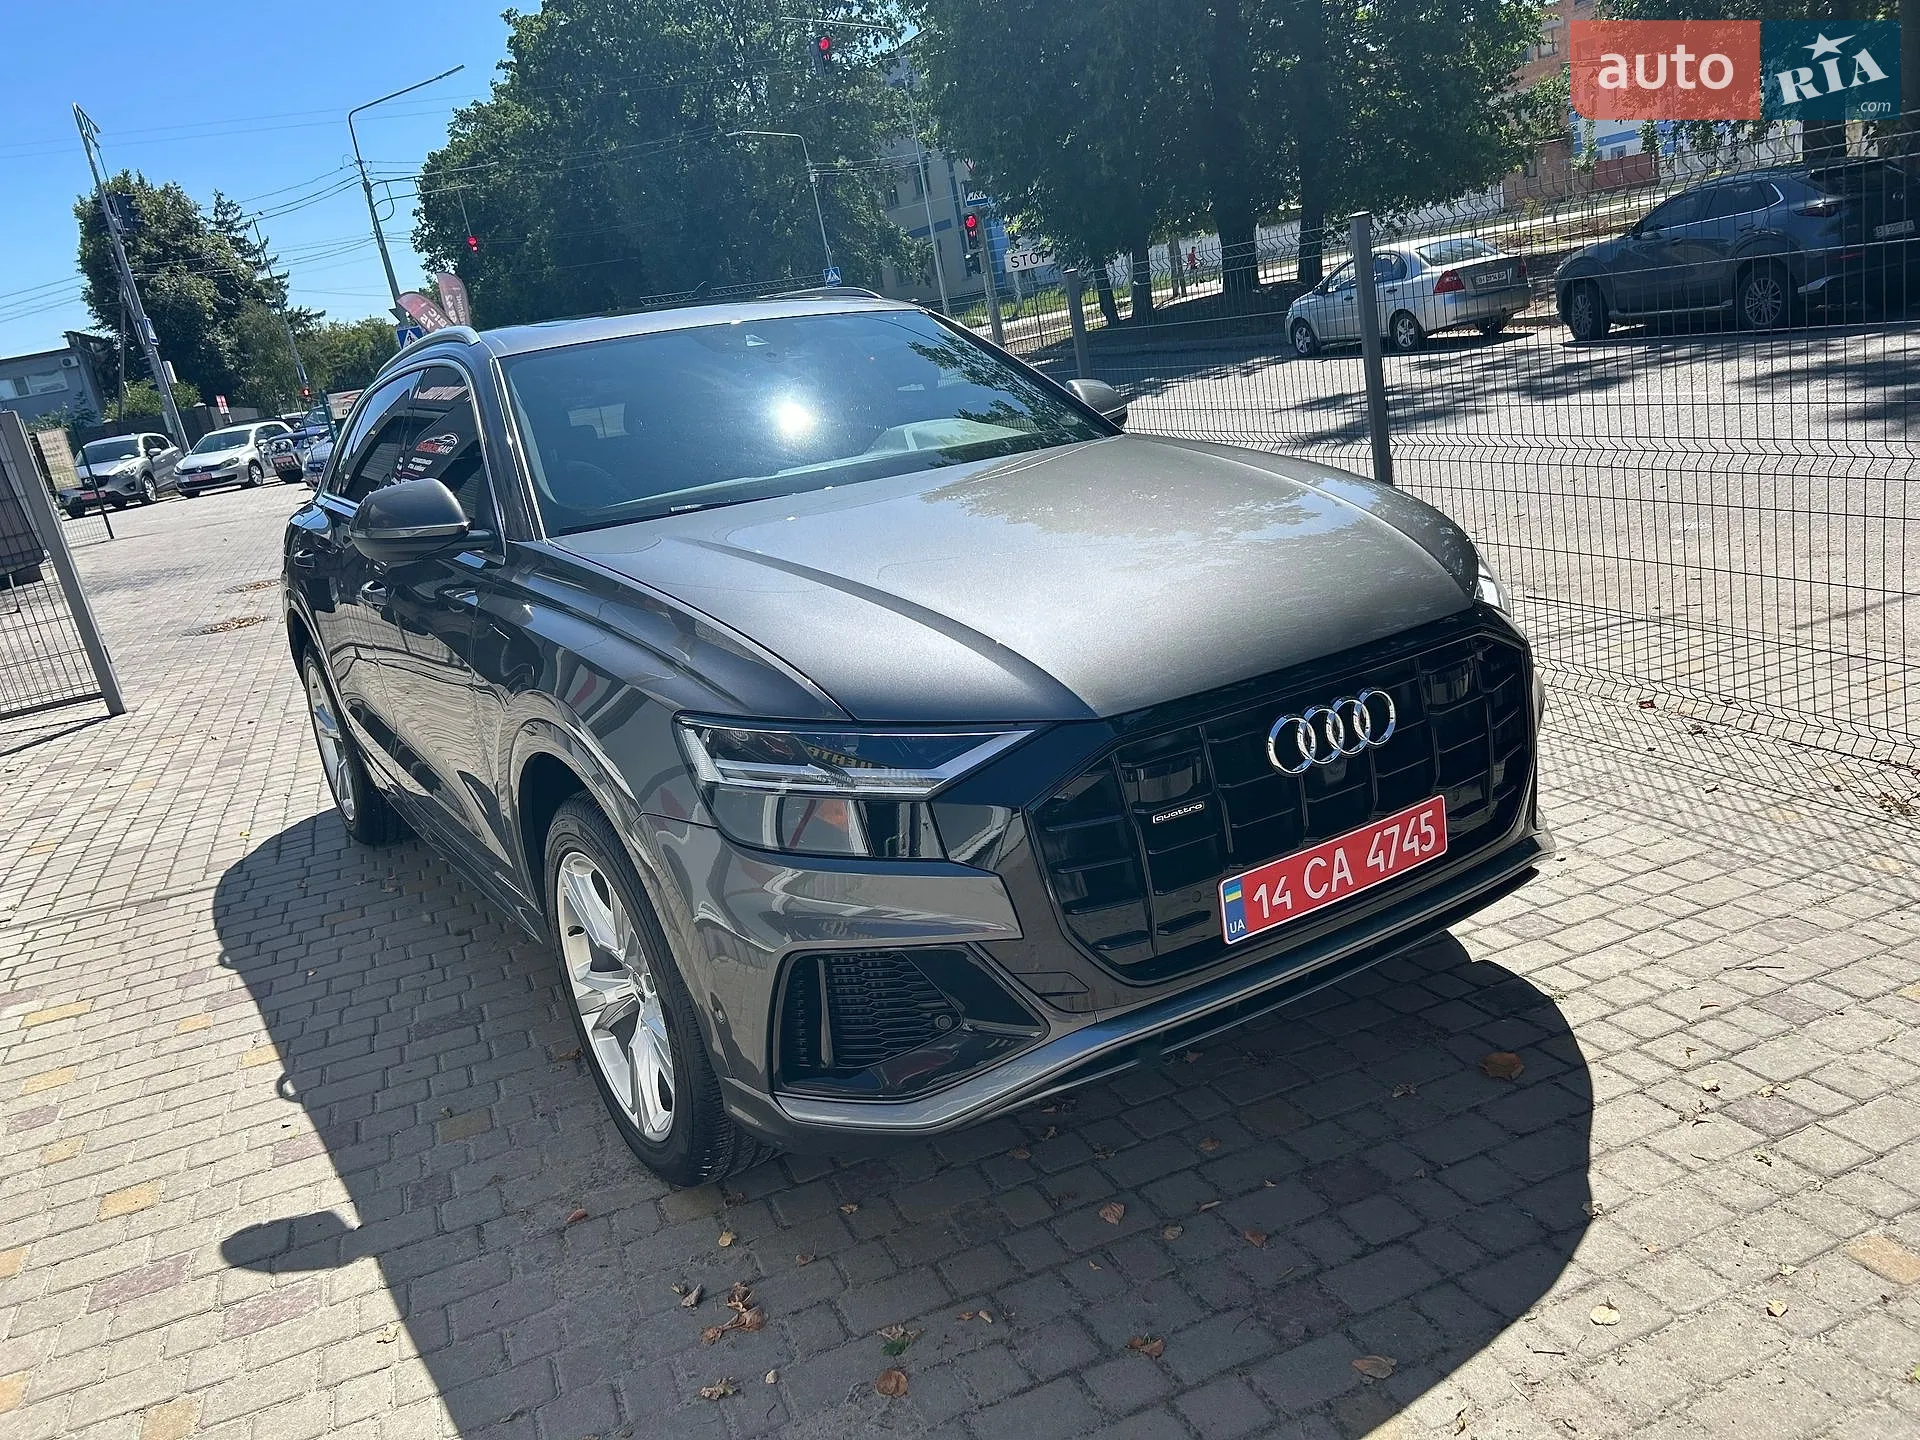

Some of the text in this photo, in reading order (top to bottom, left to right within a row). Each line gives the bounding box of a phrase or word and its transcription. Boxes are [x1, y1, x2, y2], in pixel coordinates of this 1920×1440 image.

[1010, 250, 1048, 268] STOP
[1152, 803, 1203, 824] quattro
[1252, 809, 1437, 920] 14 CA 4745
[1229, 918, 1246, 934] UA
